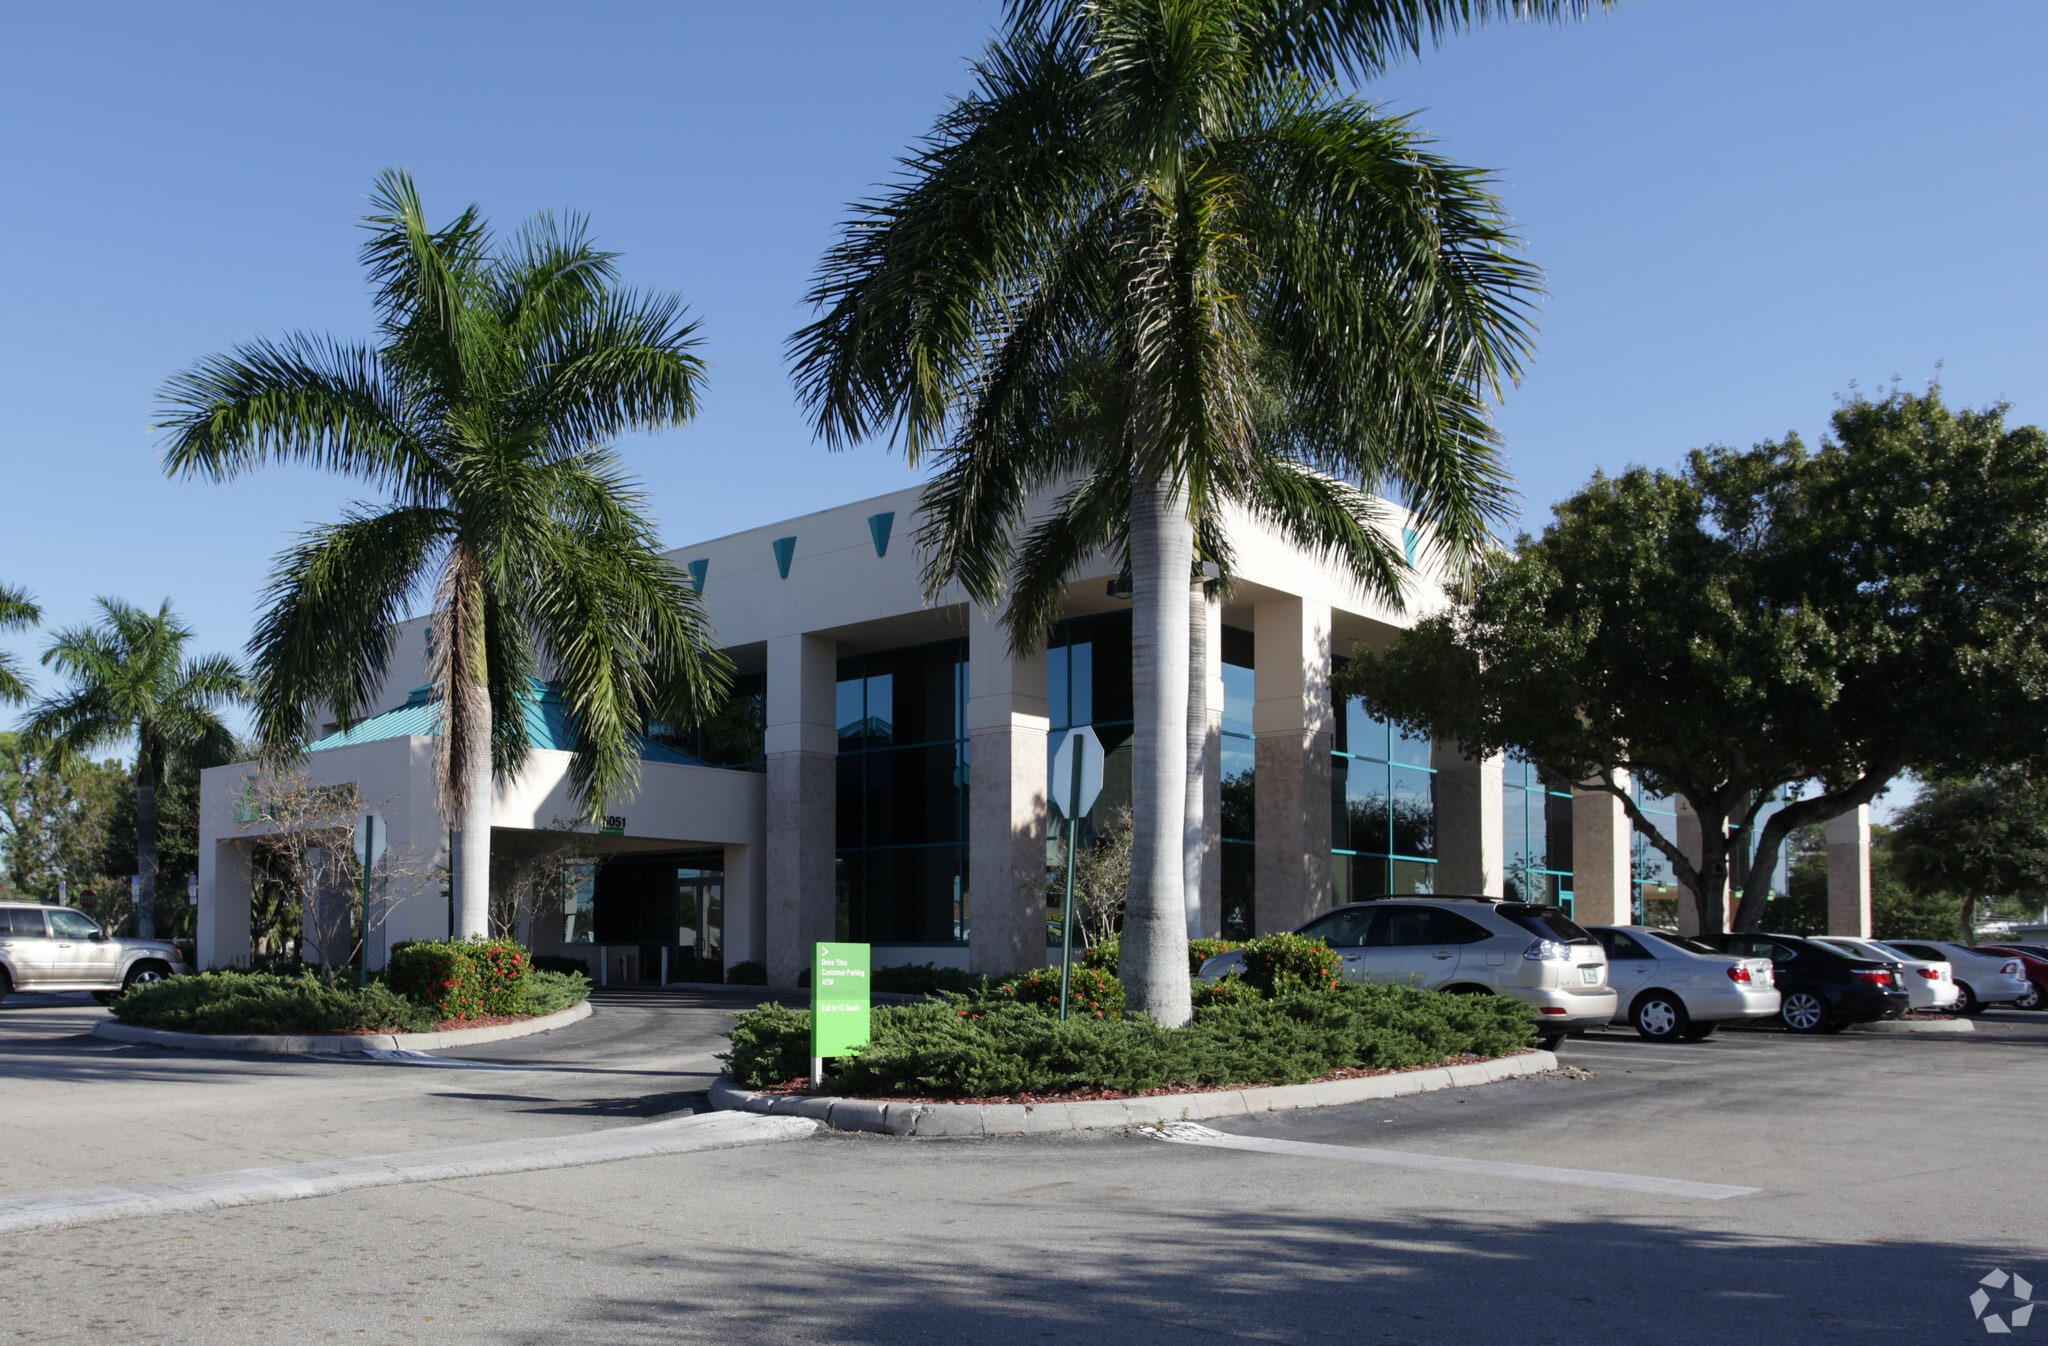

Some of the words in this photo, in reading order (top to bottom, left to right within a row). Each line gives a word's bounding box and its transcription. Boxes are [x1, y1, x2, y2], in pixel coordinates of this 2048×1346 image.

[821, 968, 846, 976] Customer
[846, 968, 865, 978] Parking
[821, 978, 834, 986] ATM
